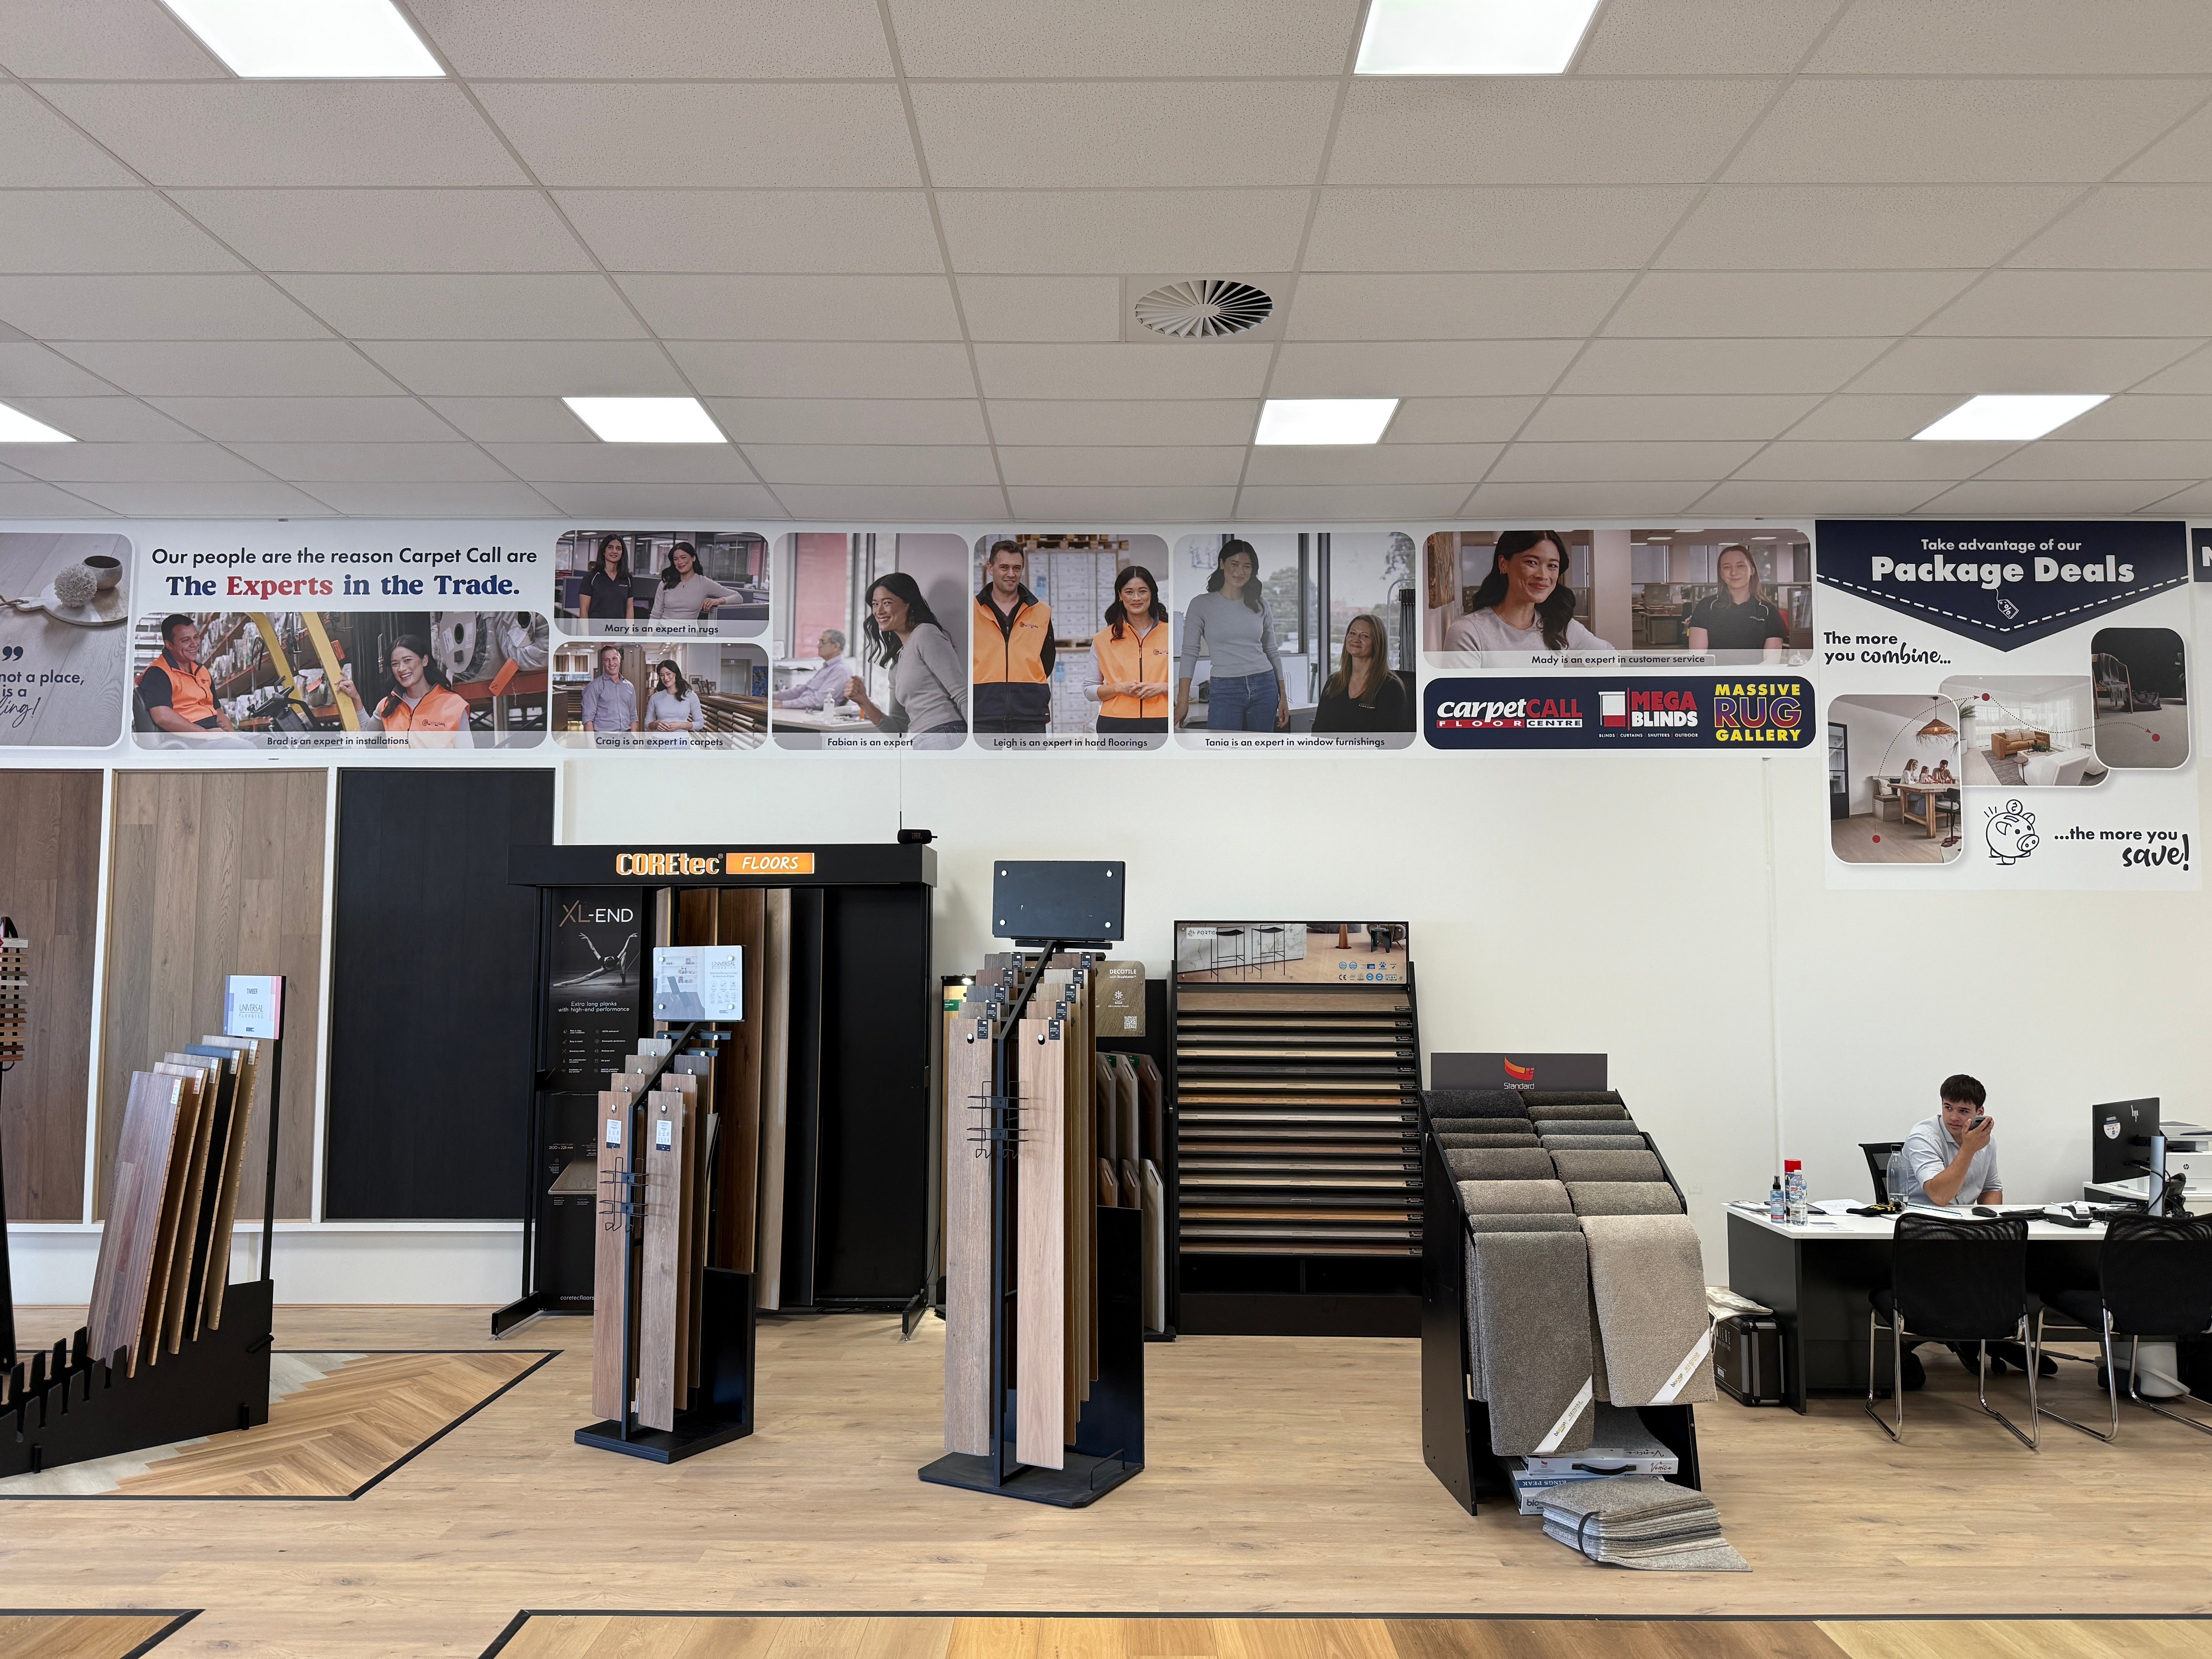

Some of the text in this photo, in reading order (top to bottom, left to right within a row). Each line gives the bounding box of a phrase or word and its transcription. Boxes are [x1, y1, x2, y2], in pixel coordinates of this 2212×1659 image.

[1921, 538, 1954, 550] Take
[1959, 539, 2035, 553] advantage
[2040, 539, 2054, 550] of
[153, 546, 537, 568] Our people are the reason Carpet Call are
[1872, 555, 2134, 591] Package Deals
[166, 574, 519, 600] The Experts in the Trade.
[605, 625, 629, 634] Mary
[656, 626, 685, 634] expert
[1824, 631, 1898, 644] The more
[1532, 655, 1558, 665] Mady
[1585, 656, 1615, 665] expert
[1824, 643, 1951, 665] you combine...
[26, 674, 35, 682] a
[40, 670, 84, 686] place,
[2, 684, 13, 697] is
[1715, 684, 1800, 695] MASSIVE
[1632, 691, 1697, 710] MEGA
[1437, 699, 1582, 723] carpetCALL
[1714, 697, 1801, 728] RUG
[1527, 719, 1582, 728] CENTRE
[1632, 711, 1698, 726] BLINDS
[268, 737, 288, 745] Brad
[314, 738, 343, 747] expert
[357, 736, 409, 744] installations
[1716, 730, 1801, 741] GALLERY
[596, 737, 620, 747] Craig
[647, 739, 677, 747] expert
[690, 739, 723, 748] carpets
[884, 739, 914, 748] expert
[994, 738, 1017, 748] Leigh
[1043, 740, 1072, 748] expert
[1109, 738, 1147, 748] floorings
[1255, 740, 1284, 748] expert
[1336, 737, 1384, 747] furnishings
[2054, 826, 2177, 843] ...the more you
[2123, 834, 2189, 871] save!
[742, 856, 800, 869] FLOORS
[559, 900, 633, 927] XL-END
[239, 1004, 263, 1012] UNIVERSAL
[1568, 1401, 1582, 1418] SEDONA
[1650, 1462, 1672, 1472] Venice
